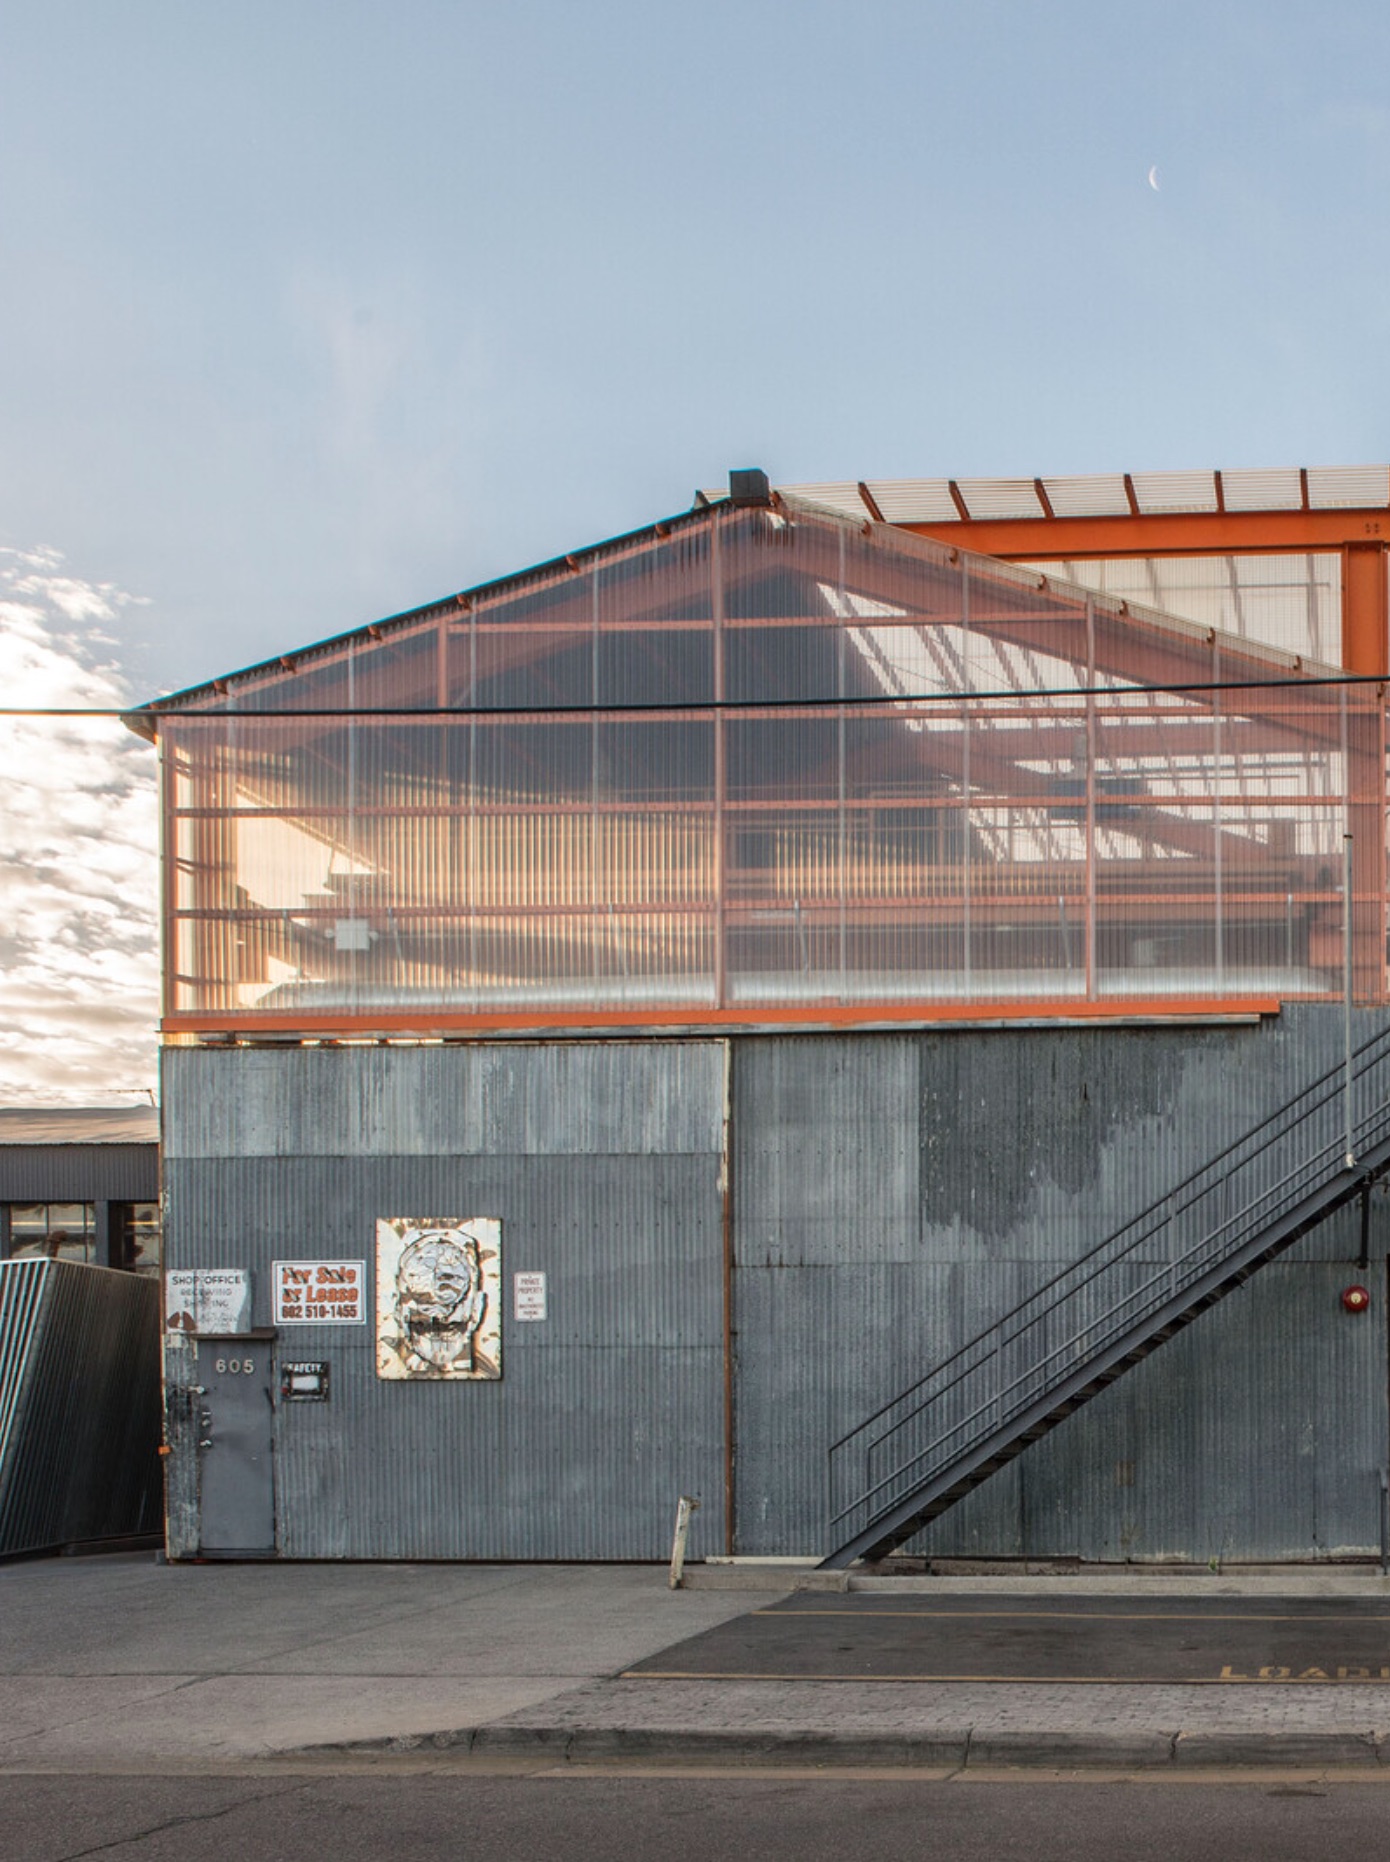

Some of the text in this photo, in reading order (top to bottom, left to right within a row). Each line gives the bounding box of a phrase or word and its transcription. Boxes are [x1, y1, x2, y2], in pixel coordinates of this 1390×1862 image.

[171, 1275, 242, 1286] SHOP OFFICE
[282, 1266, 313, 1284] For
[282, 1285, 360, 1303] or Lease
[215, 1359, 254, 1374] 605
